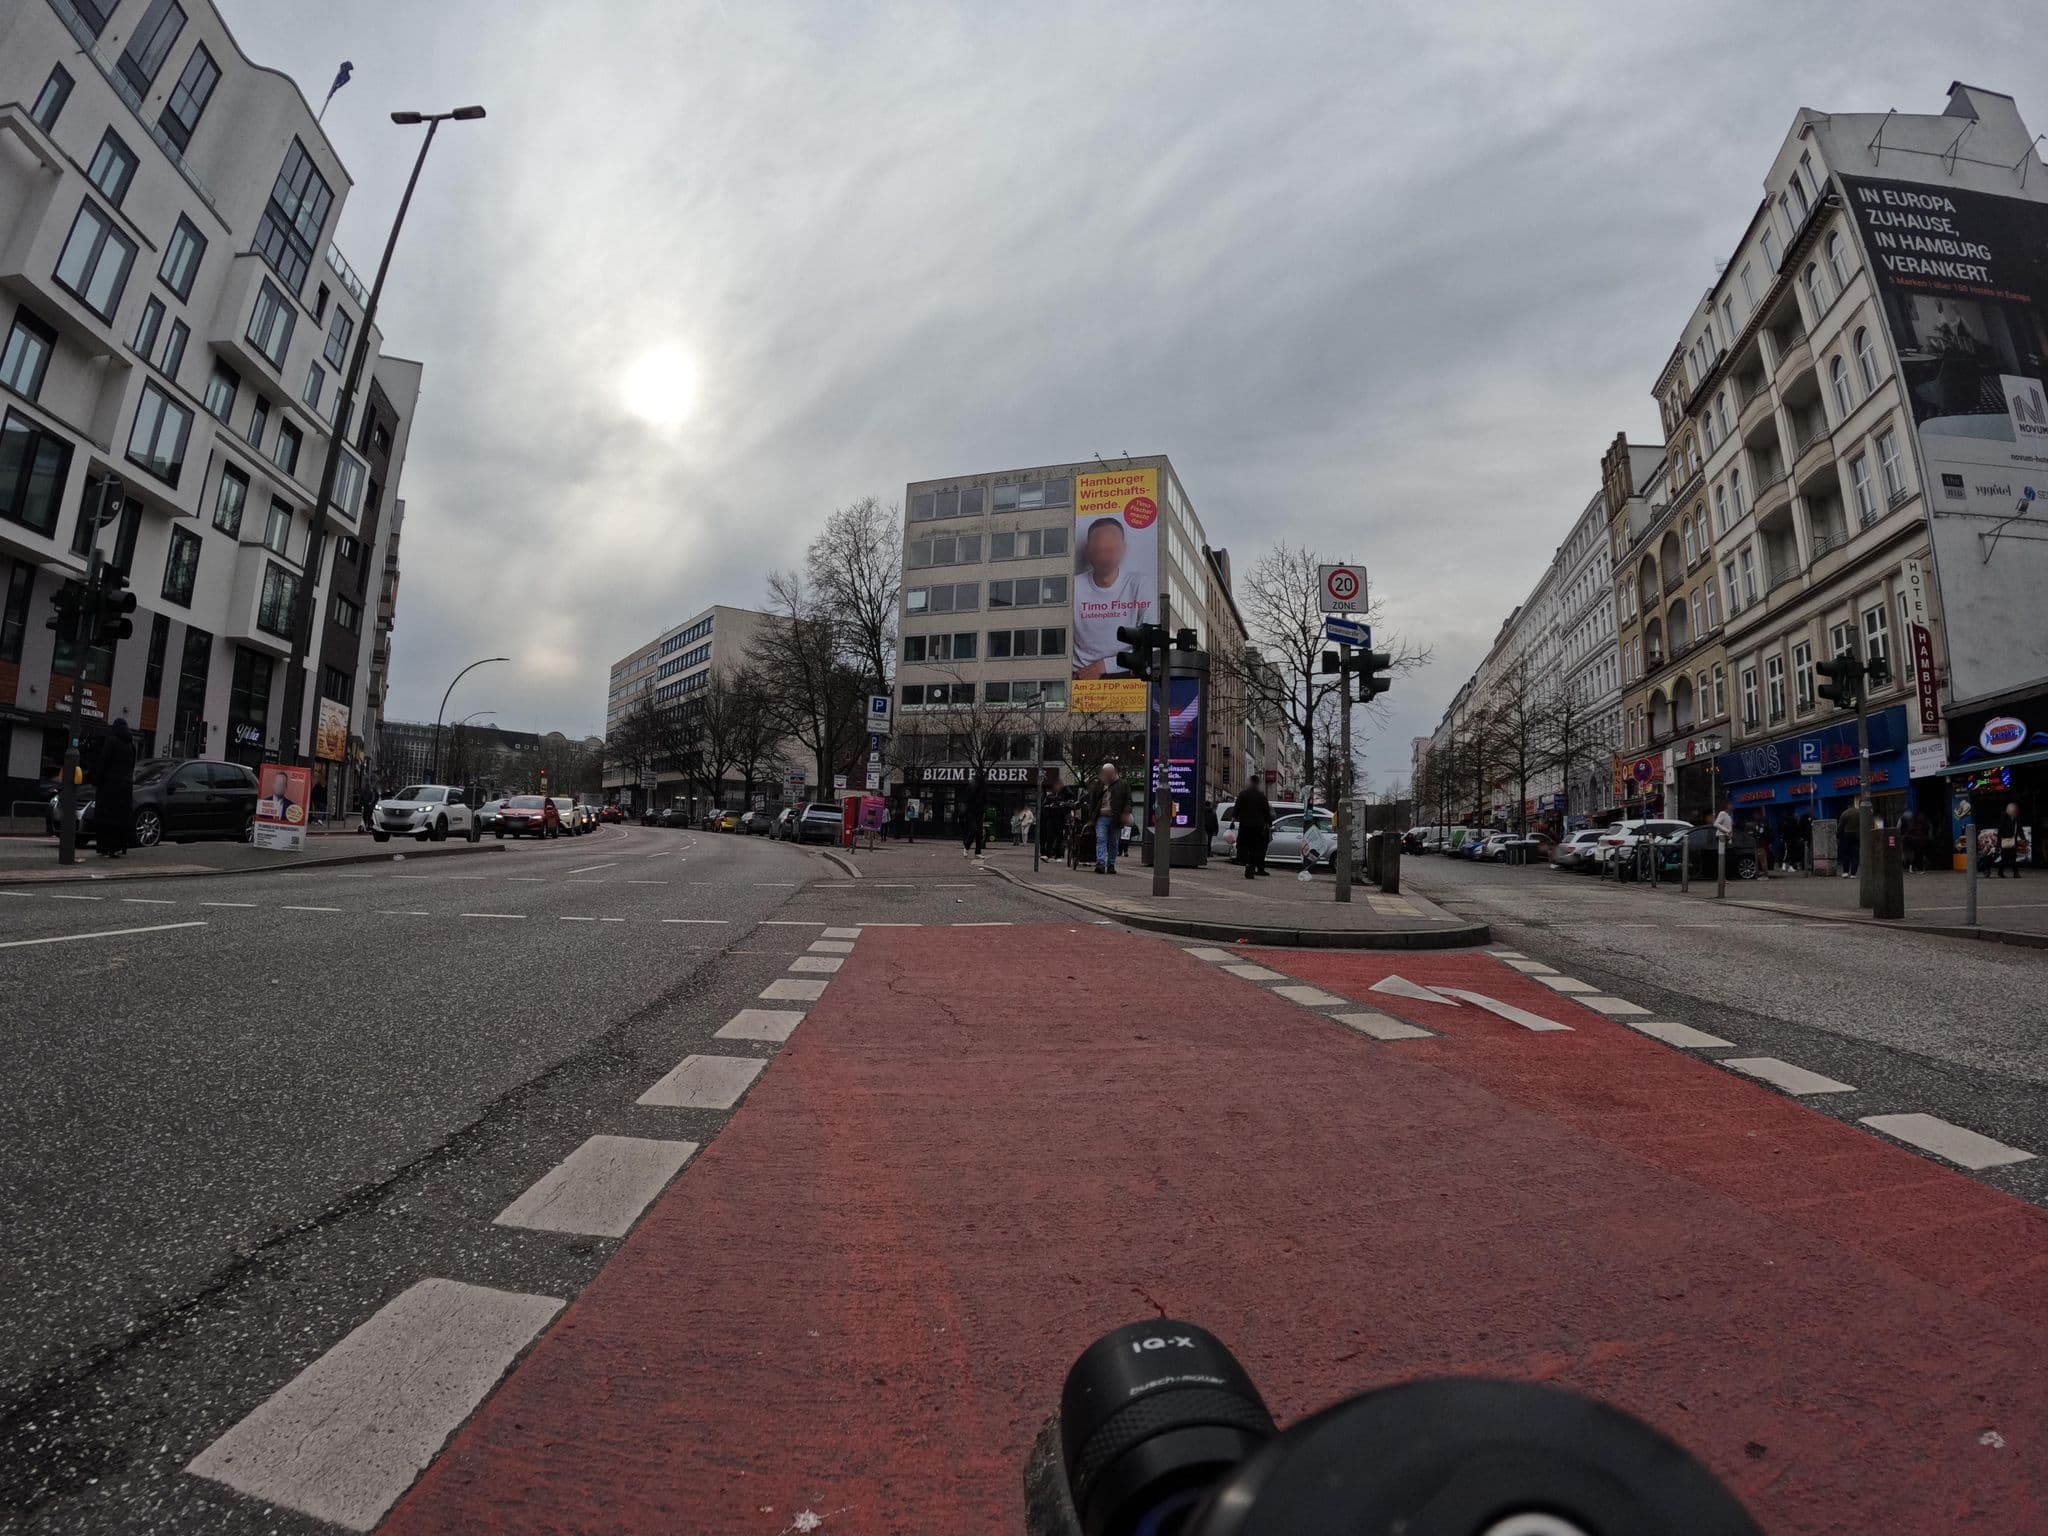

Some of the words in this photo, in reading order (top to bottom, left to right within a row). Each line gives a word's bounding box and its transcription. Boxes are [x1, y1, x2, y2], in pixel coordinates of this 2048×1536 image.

[1858, 187, 1879, 203] IN
[1882, 190, 1957, 213] EUROPA
[1865, 209, 1960, 237] ZUHAUSE,
[1874, 231, 1895, 248] IN
[1899, 234, 1992, 260] HAMBURG
[1881, 254, 1993, 283] VERANKERT.
[1080, 474, 1145, 488] Hamburger
[1080, 485, 1150, 499] Wirtschafts-
[1080, 500, 1121, 512] wende.
[1335, 577, 1353, 592] 20
[1081, 601, 1108, 611] Timo
[1111, 600, 1152, 610] Fischer
[1332, 601, 1357, 611] ZONE
[1081, 611, 1121, 620] Listenplatz
[1909, 562, 1925, 625] HOTEL
[1918, 632, 1935, 721] HAMBURG
[1074, 683, 1087, 691] Am
[1104, 682, 1121, 690] FDP
[1803, 743, 1815, 760] P
[922, 768, 964, 781] BIZIM
[1132, 1336, 1196, 1354] IQ-X
